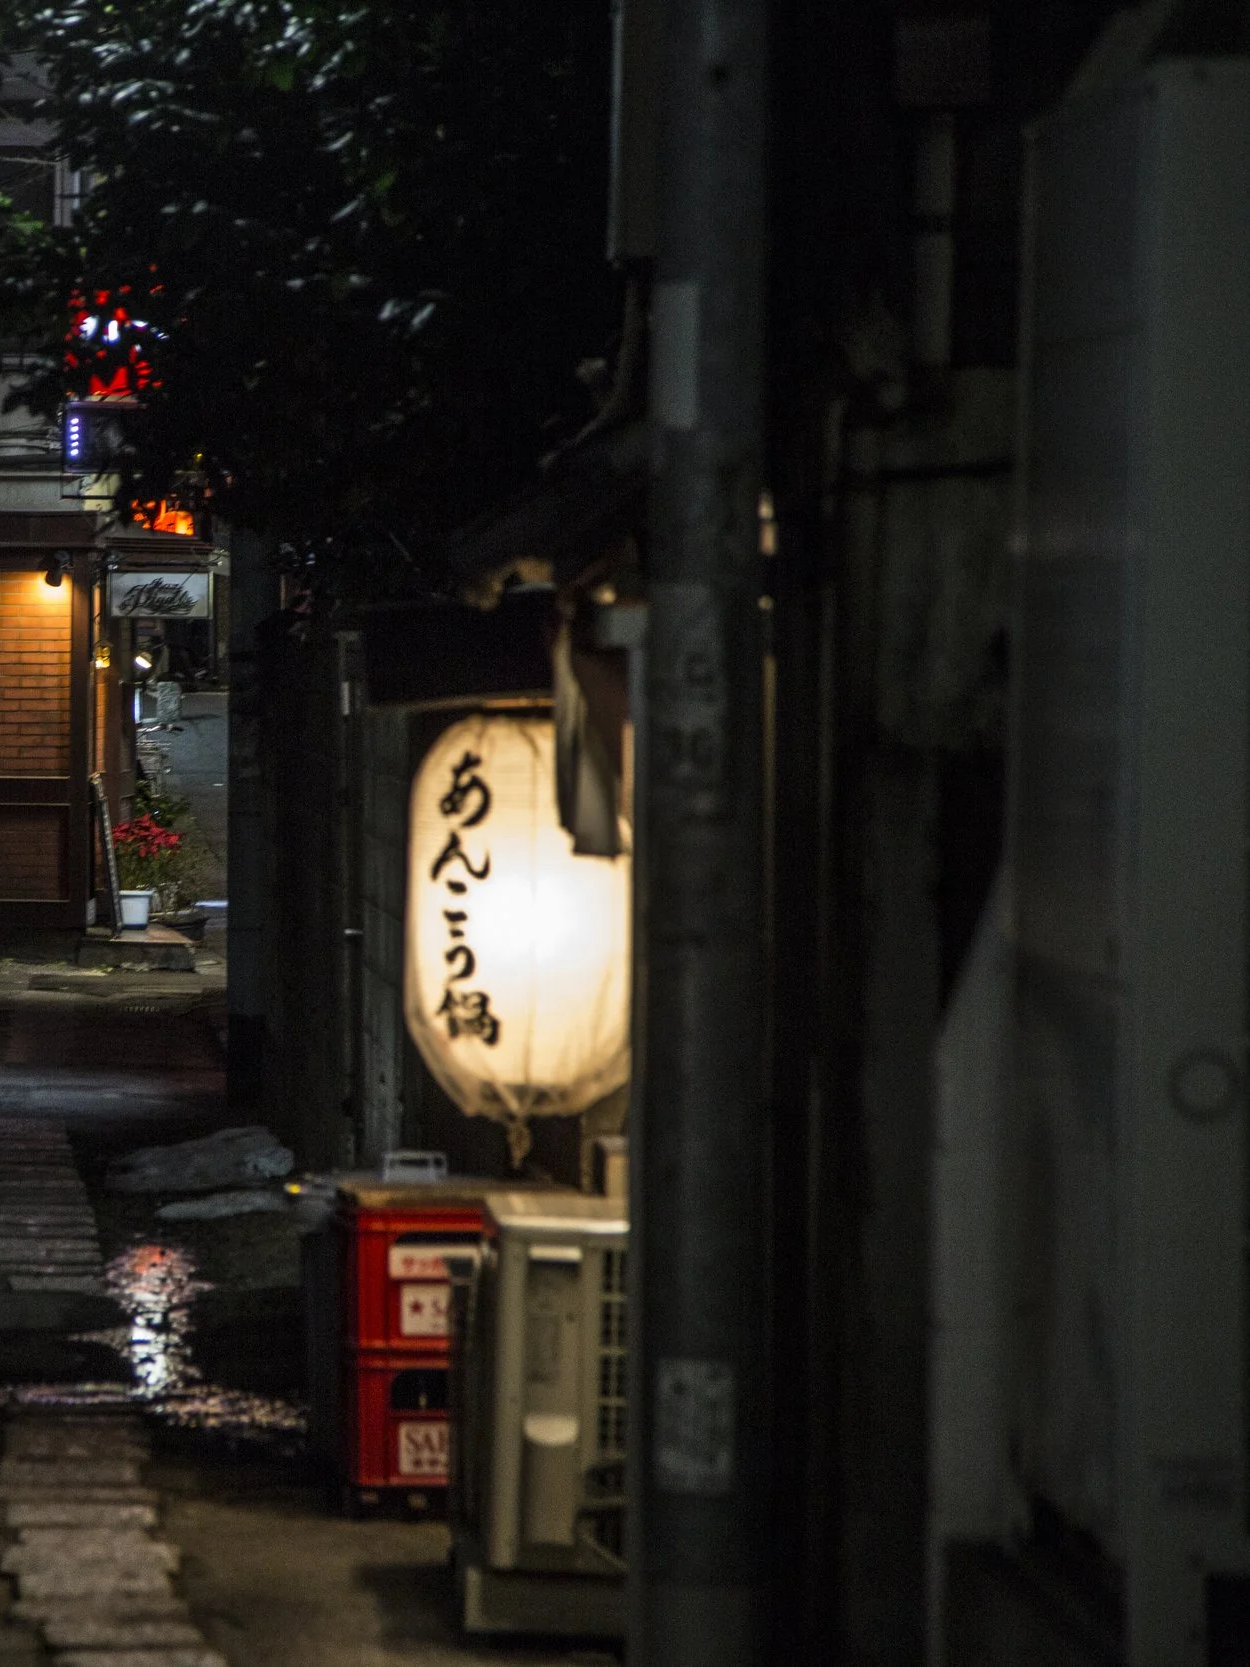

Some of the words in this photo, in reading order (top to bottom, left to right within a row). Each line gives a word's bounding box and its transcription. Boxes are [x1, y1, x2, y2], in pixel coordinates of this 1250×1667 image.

[431, 751, 501, 1046] あんこう鍋
